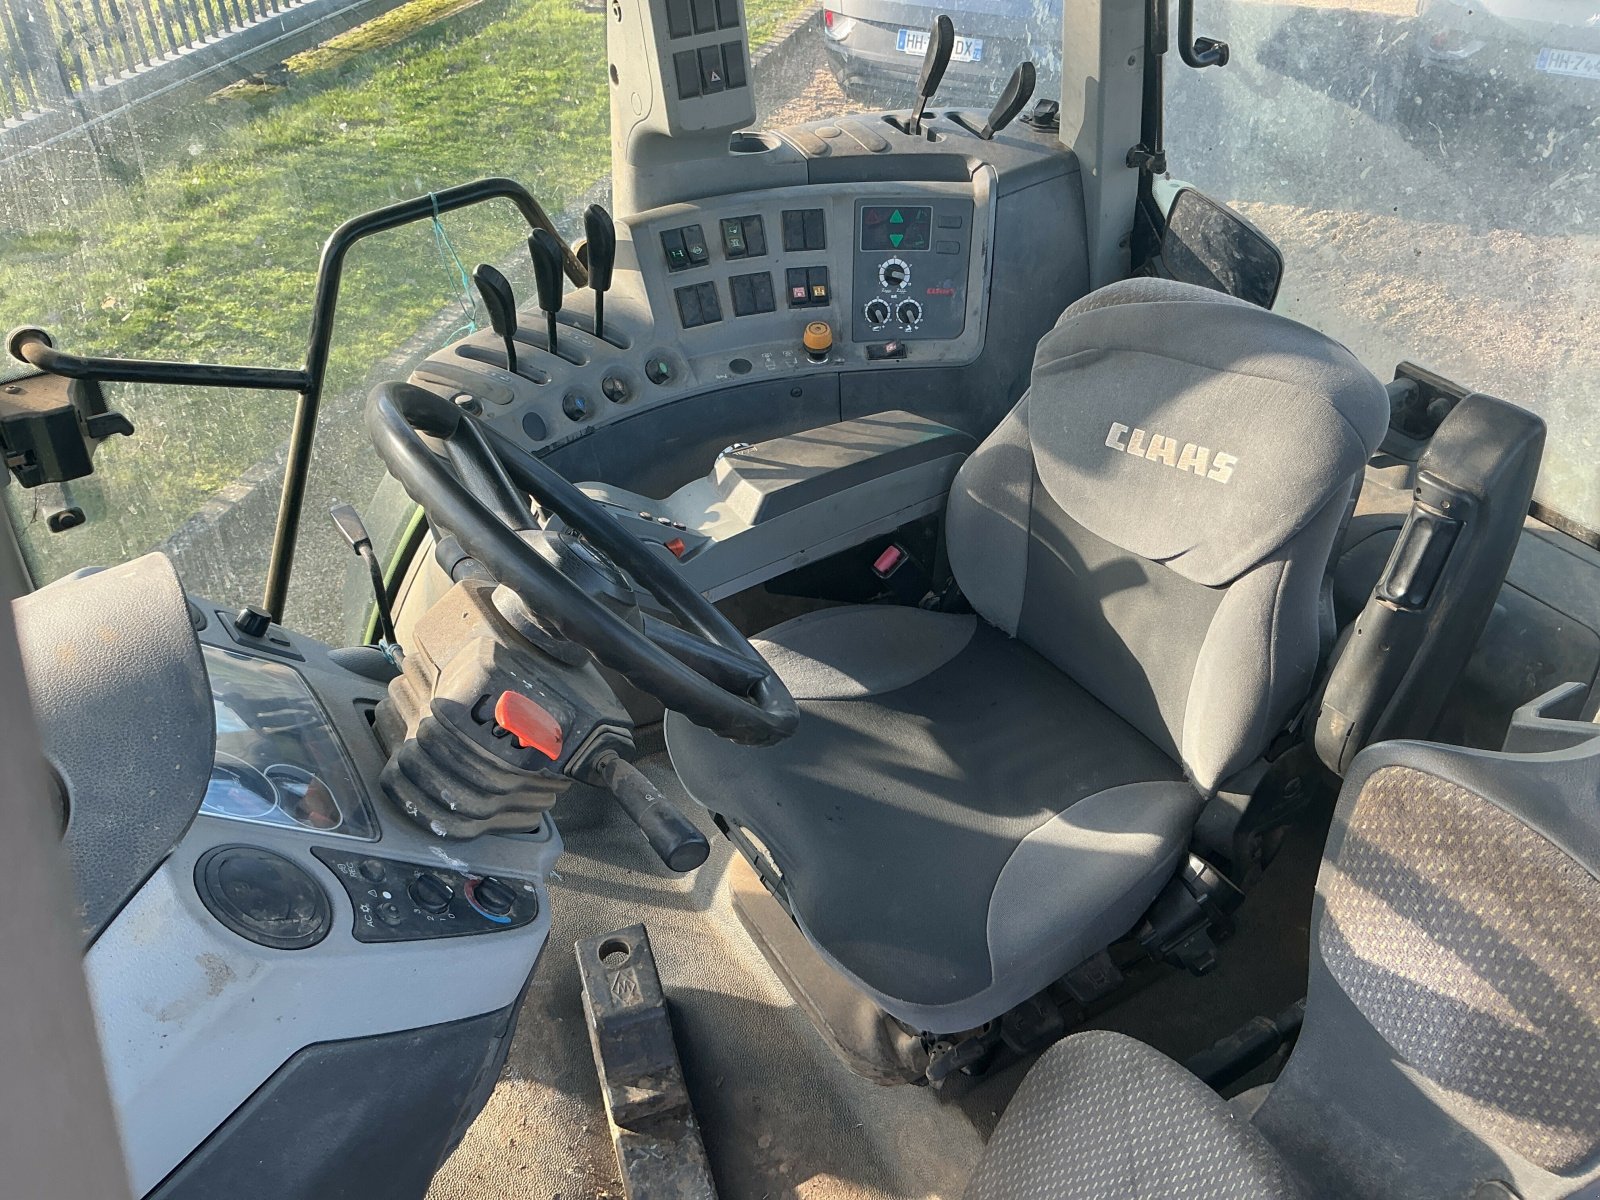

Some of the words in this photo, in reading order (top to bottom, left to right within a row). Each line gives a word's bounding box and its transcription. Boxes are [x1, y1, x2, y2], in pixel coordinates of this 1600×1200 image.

[1105, 421, 1239, 485] CLAAS
[346, 861, 357, 878] REC
[364, 914, 375, 928] AC
